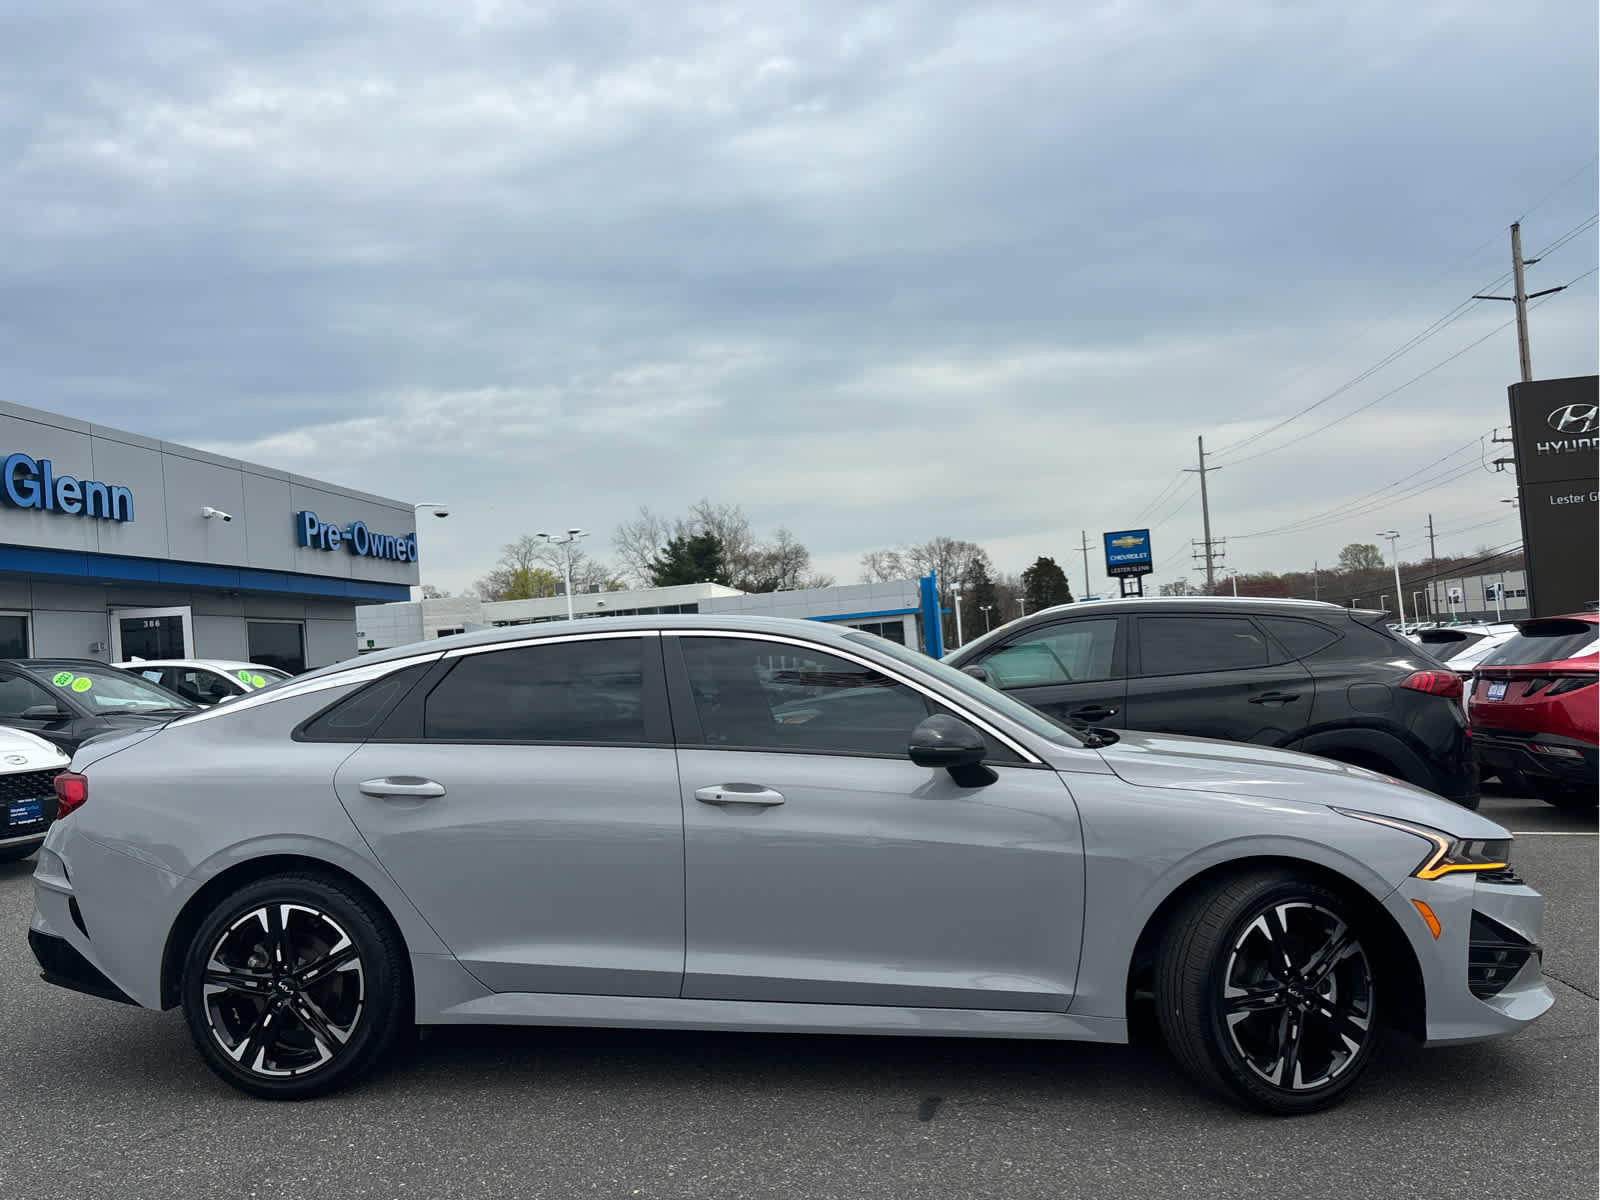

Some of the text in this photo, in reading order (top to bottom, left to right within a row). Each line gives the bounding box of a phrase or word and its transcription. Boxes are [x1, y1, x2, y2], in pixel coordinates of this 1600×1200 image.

[4, 453, 134, 522] Glenn
[1550, 493, 1585, 504] Lester
[297, 510, 417, 562] Pre-Owned
[1110, 553, 1147, 561] CHEVROLET
